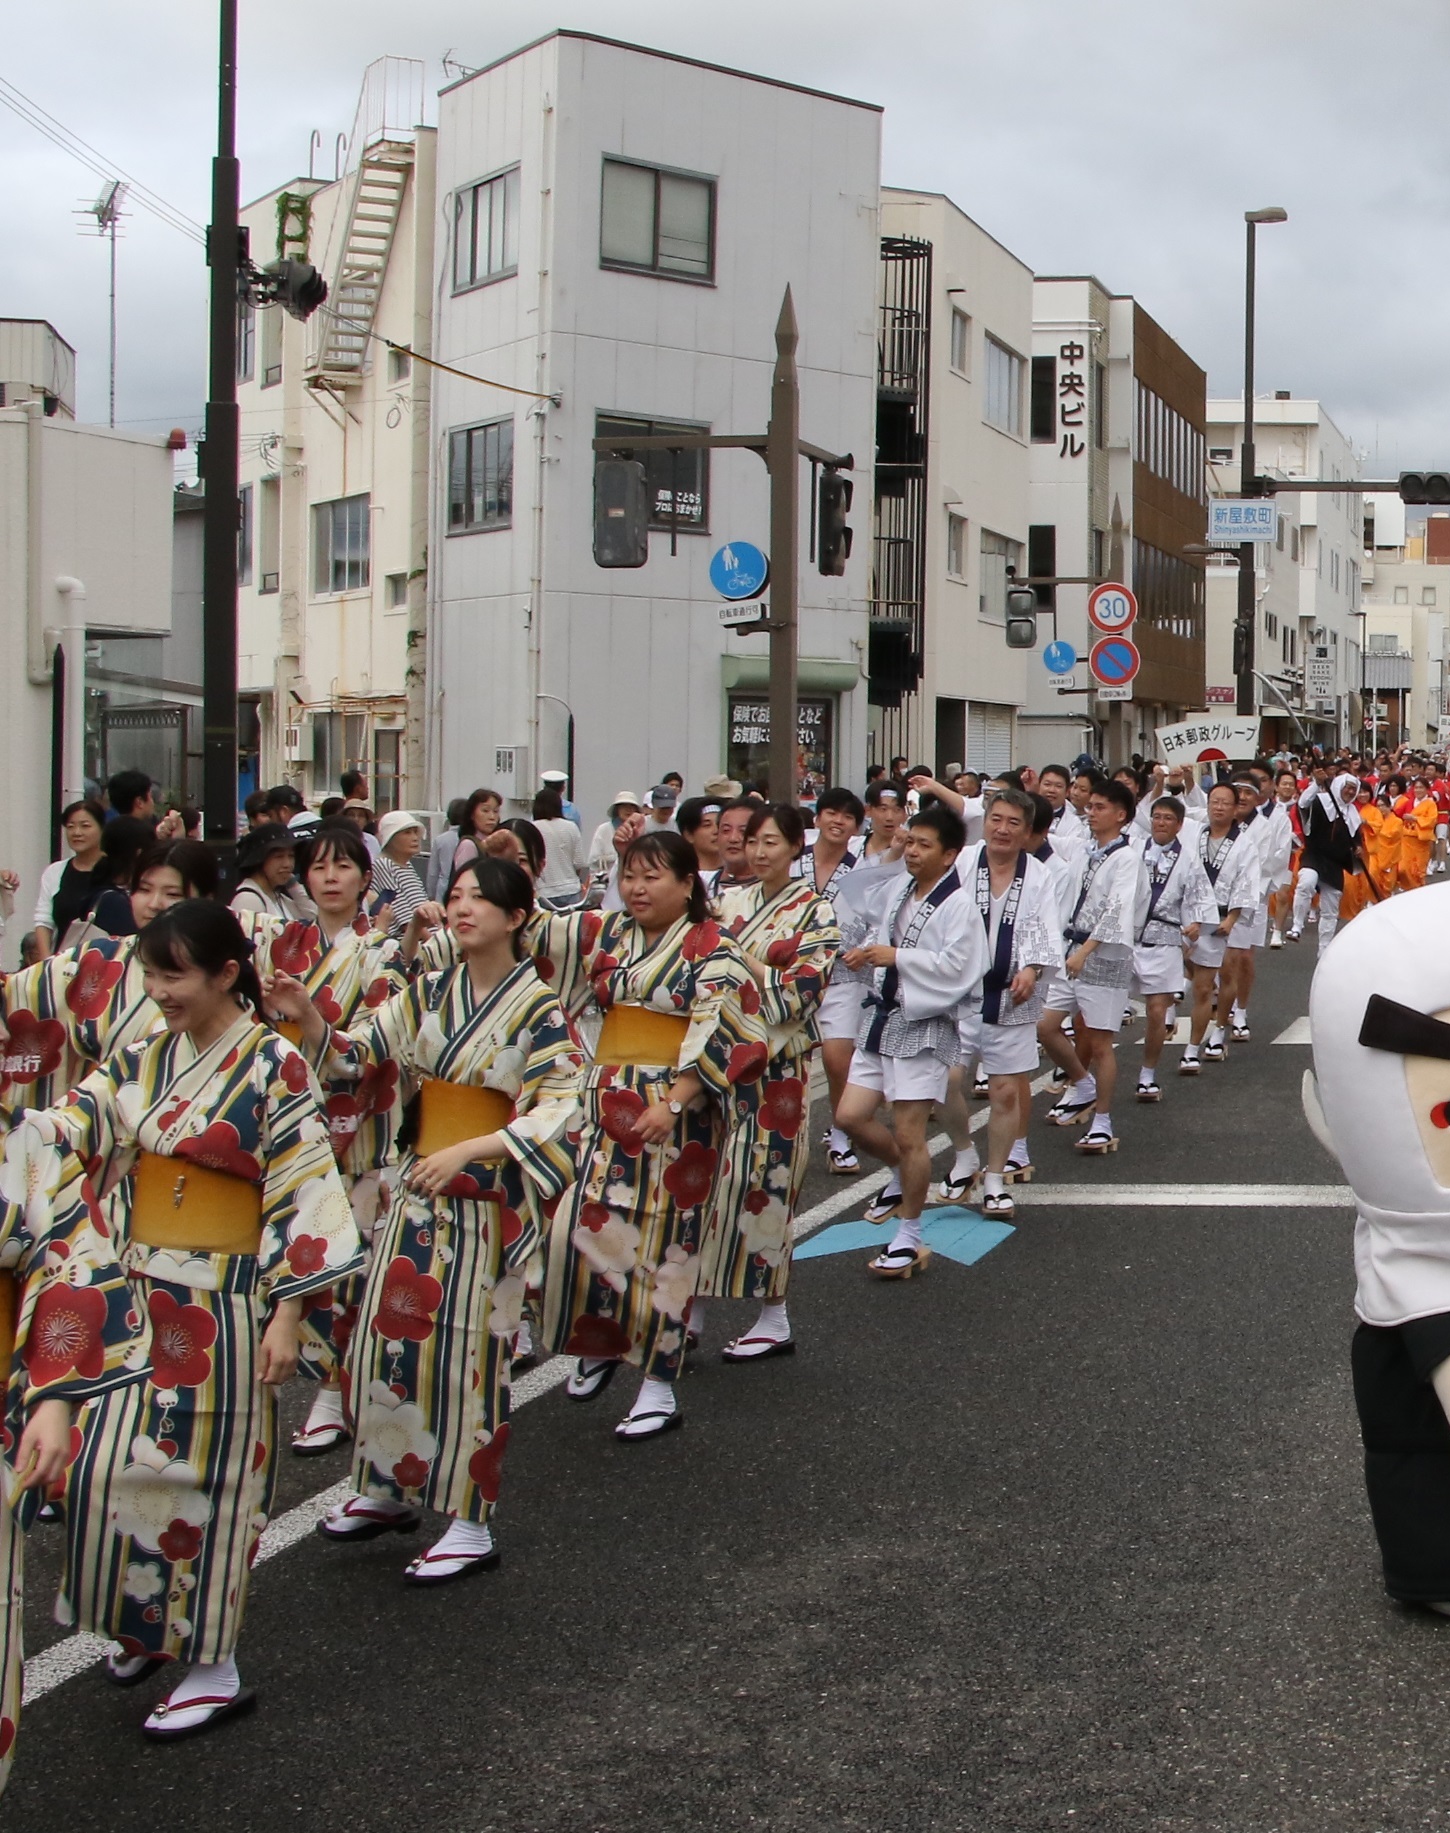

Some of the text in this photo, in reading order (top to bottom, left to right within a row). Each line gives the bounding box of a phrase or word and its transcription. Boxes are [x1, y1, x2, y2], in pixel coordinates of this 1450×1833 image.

[1059, 341, 1085, 458] 中央ビル
[658, 489, 701, 504] 保険ことなら
[1214, 507, 1272, 524] 新屋敷町
[719, 604, 759, 619] 自転車通行可
[1099, 598, 1125, 618] 30
[1162, 724, 1258, 752] 日本郵政グループ
